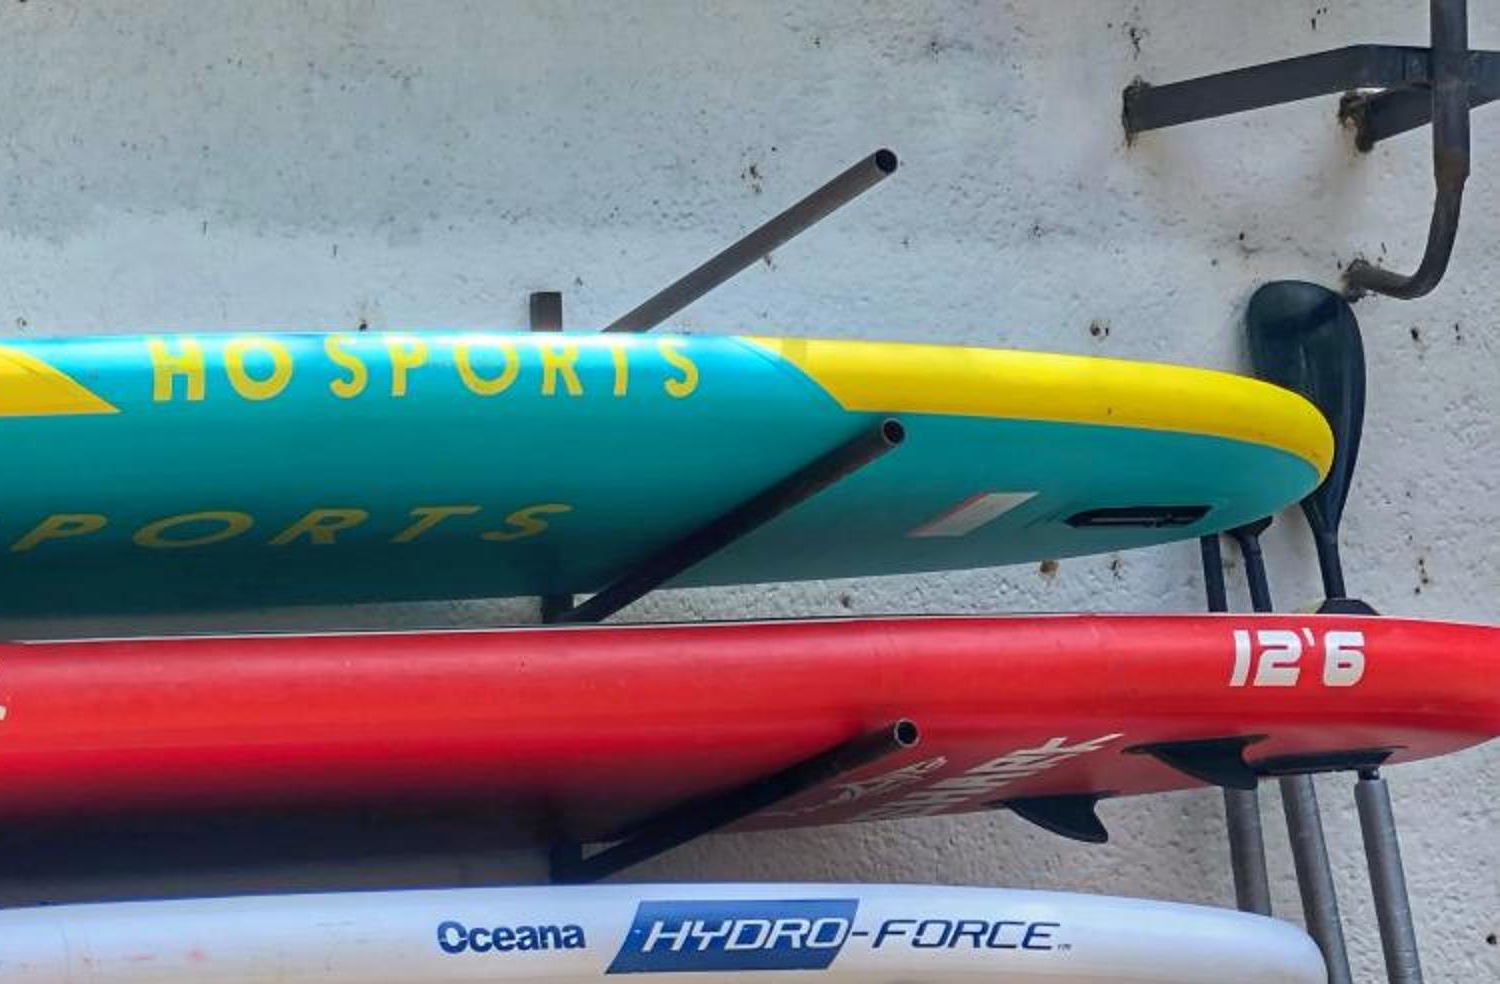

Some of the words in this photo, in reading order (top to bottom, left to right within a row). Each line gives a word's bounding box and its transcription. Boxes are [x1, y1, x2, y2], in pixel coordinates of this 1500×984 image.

[146, 338, 293, 400] HO
[323, 332, 699, 399] SPORTS
[437, 920, 586, 955] Oceana
[642, 917, 1061, 954] HYDRO-FORCE
